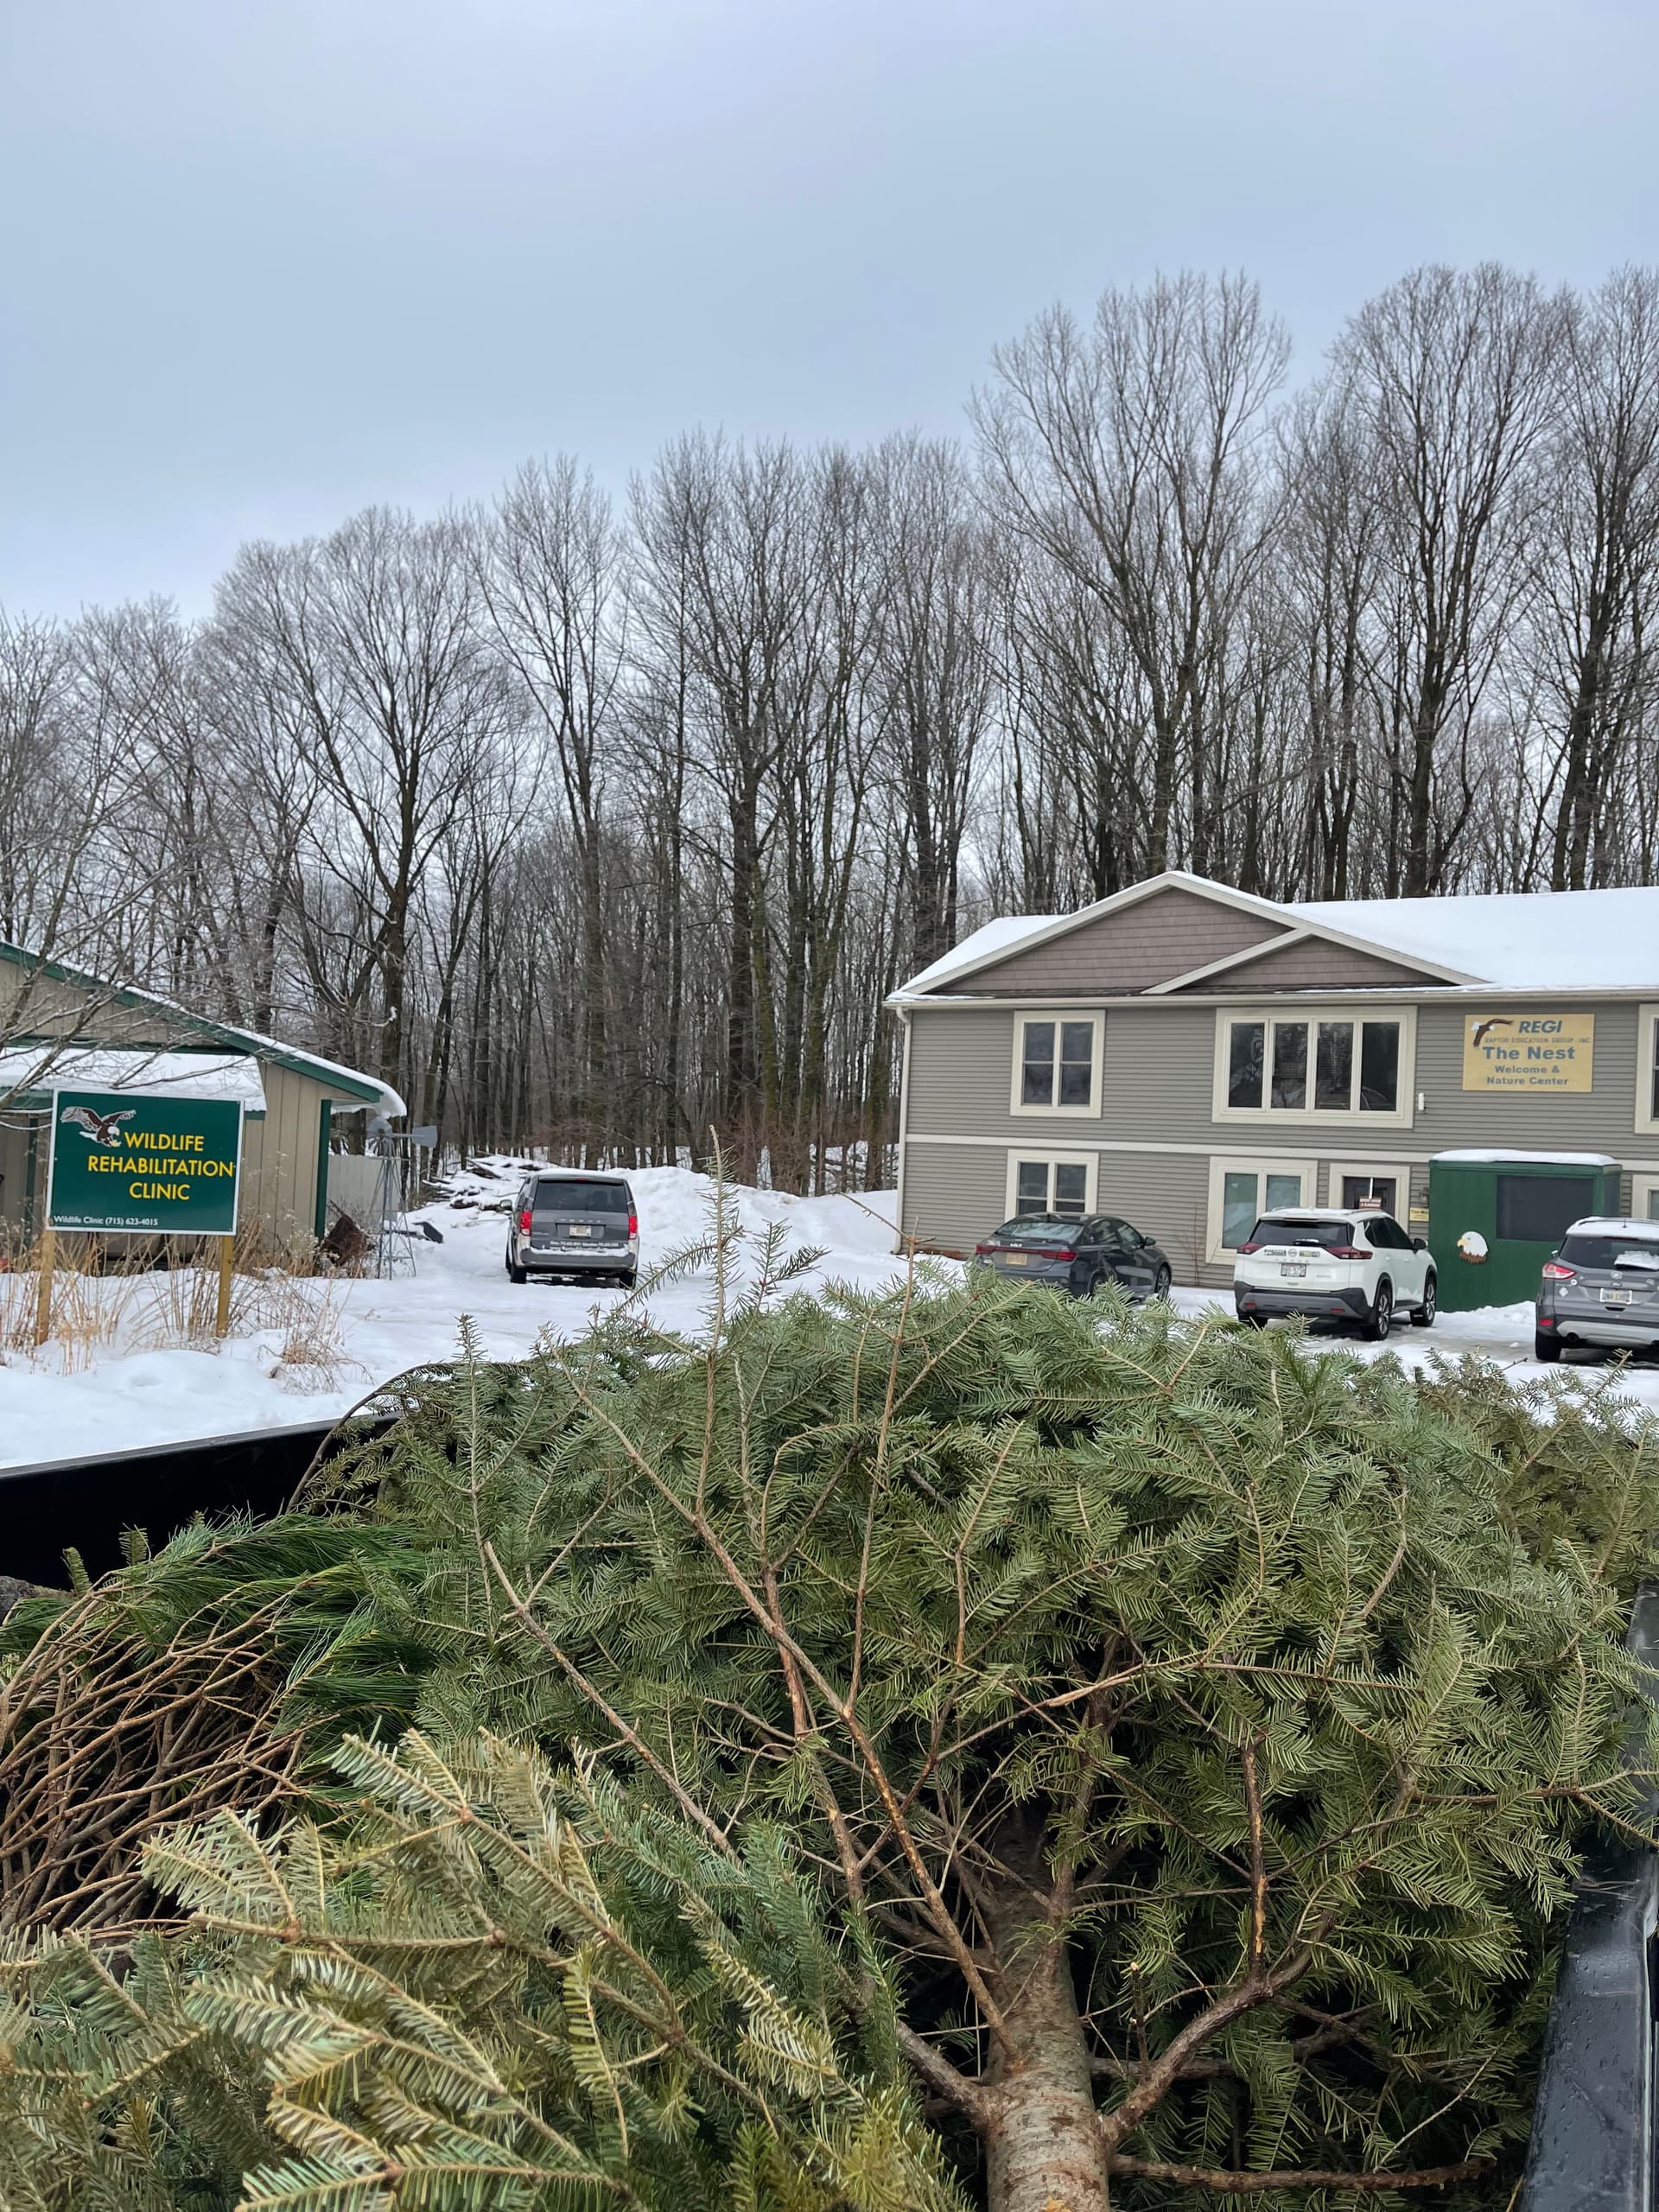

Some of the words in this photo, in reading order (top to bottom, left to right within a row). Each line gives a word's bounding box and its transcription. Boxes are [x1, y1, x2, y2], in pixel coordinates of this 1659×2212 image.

[1518, 1020, 1562, 1033] REGI
[1483, 1046, 1520, 1059] The
[1528, 1046, 1575, 1059] Nest
[1495, 1065, 1547, 1074] Welcome
[1552, 1065, 1560, 1074] &
[1486, 1077, 1525, 1085] Nature
[1529, 1077, 1568, 1085] Center
[124, 1132, 204, 1152] WILDLIFE
[87, 1155, 234, 1177] REHABILITATION
[129, 1182, 190, 1200] CLINIC
[54, 1215, 82, 1224] Wildlife
[105, 1217, 124, 1226] (715)
